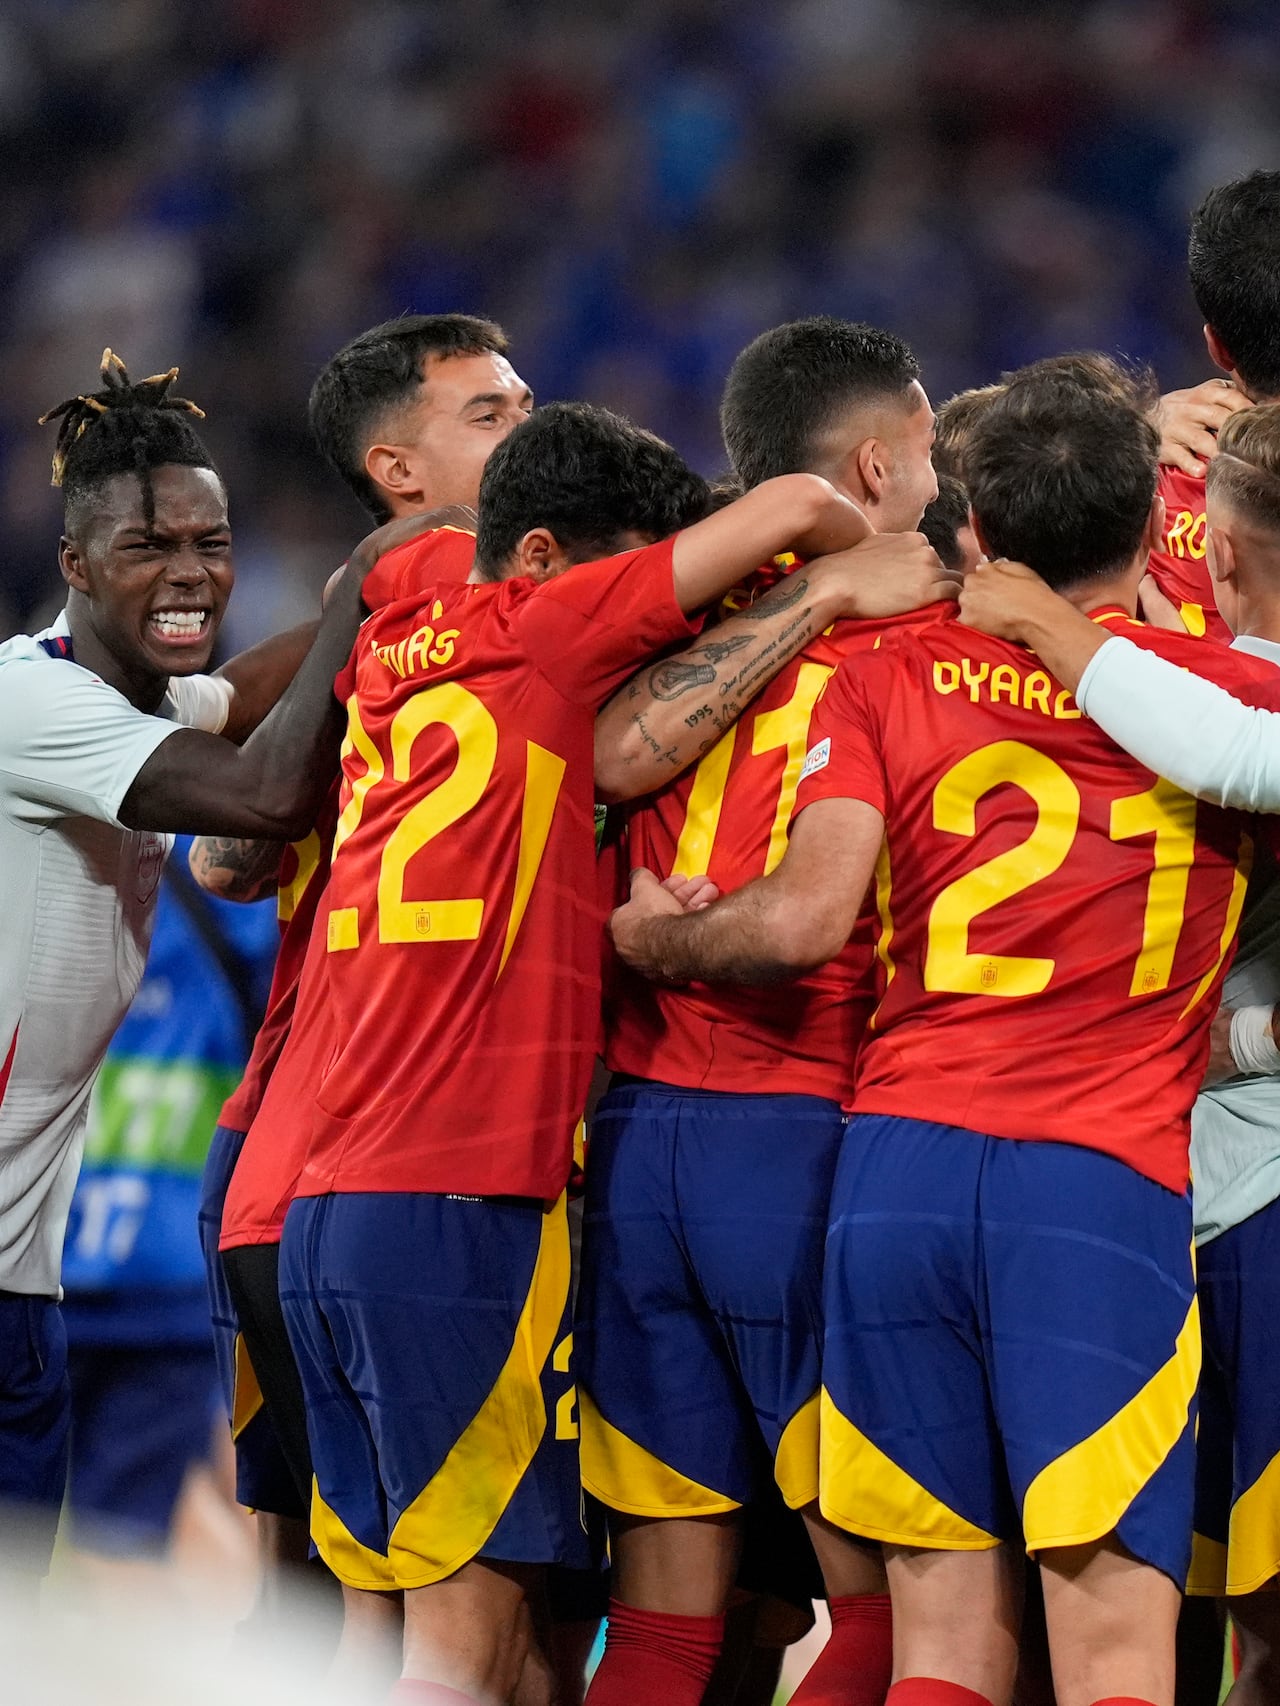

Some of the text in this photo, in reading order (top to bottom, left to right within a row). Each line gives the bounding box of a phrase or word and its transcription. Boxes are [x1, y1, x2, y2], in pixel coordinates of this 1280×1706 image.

[371, 626, 461, 679] AVAS
[684, 704, 713, 728] 1995
[924, 739, 1198, 998] 21
